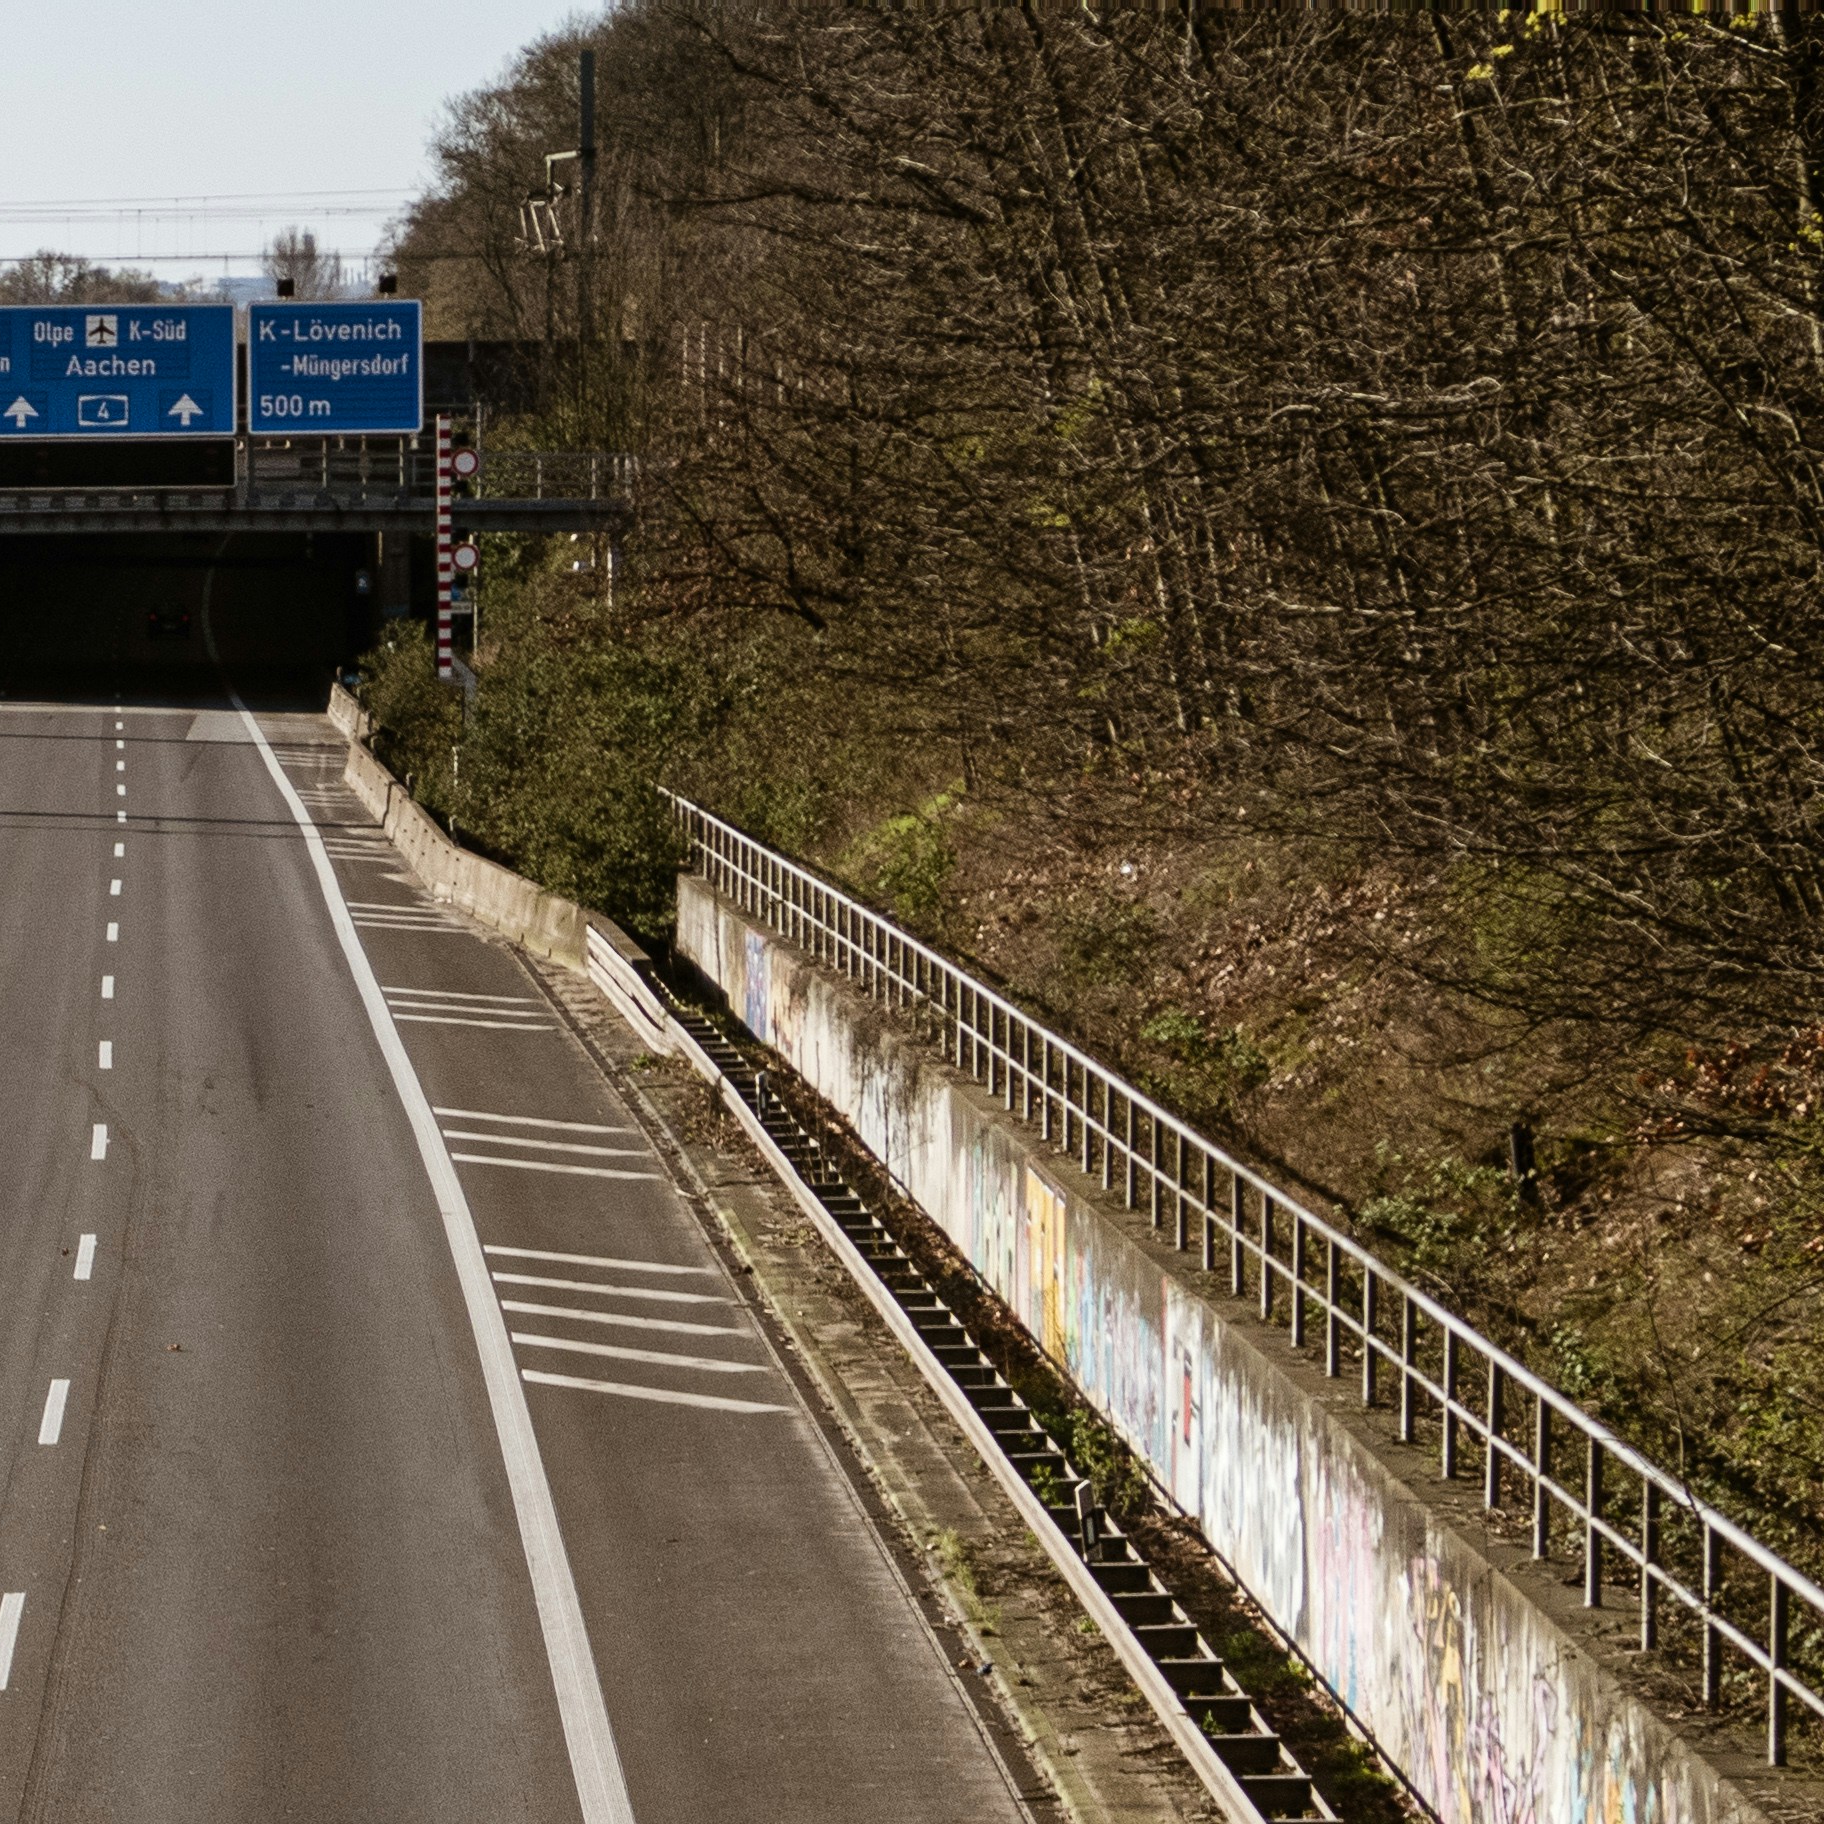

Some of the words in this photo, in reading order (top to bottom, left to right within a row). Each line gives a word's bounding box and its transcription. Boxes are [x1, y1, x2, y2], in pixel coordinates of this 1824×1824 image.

[33, 321, 74, 347] Olpe
[129, 320, 186, 341] K-Süd
[65, 354, 156, 376] Aachen
[281, 352, 409, 381] -Müngersdorf
[97, 401, 110, 419] 4
[260, 395, 303, 417] 500
[308, 399, 331, 416] m
